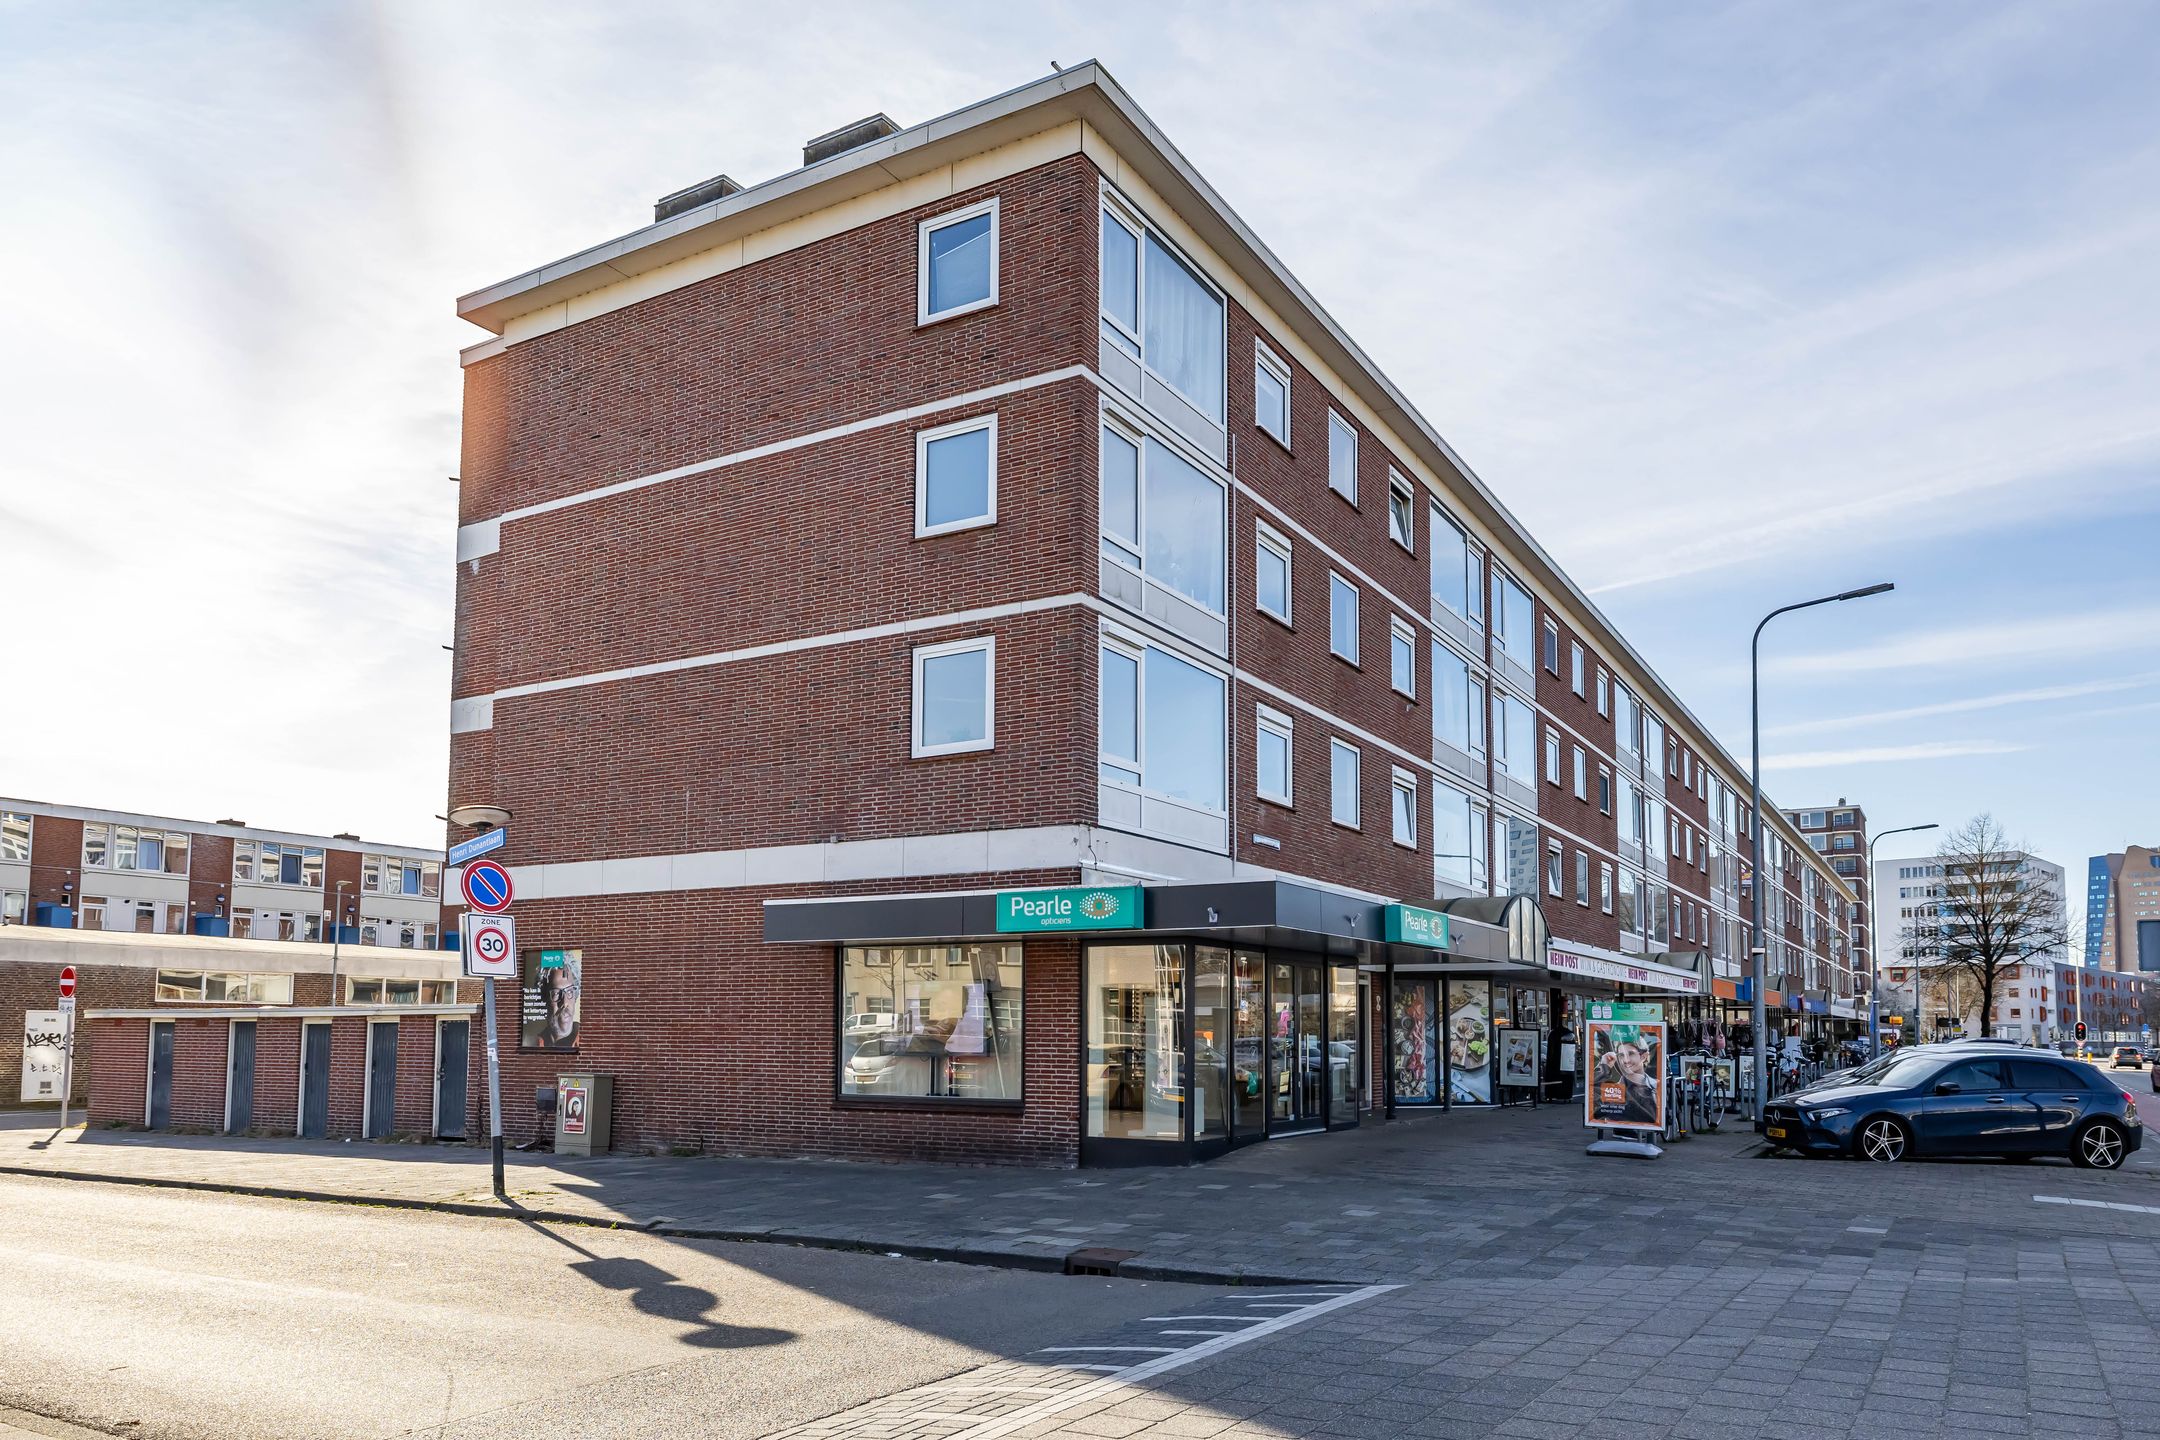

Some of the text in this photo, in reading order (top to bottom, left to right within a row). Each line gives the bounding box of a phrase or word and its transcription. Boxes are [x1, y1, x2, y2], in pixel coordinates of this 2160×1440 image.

[452, 835, 501, 859] Henri Dunantlaan
[1011, 895, 1072, 917] Pearle
[481, 918, 501, 926] ZONE
[1040, 917, 1072, 926] opticiens
[1405, 910, 1428, 932] Pearle
[482, 938, 503, 952] 30
[1550, 952, 1564, 966] HEIN
[1565, 955, 1579, 970] POST
[1638, 970, 1649, 981] POST
